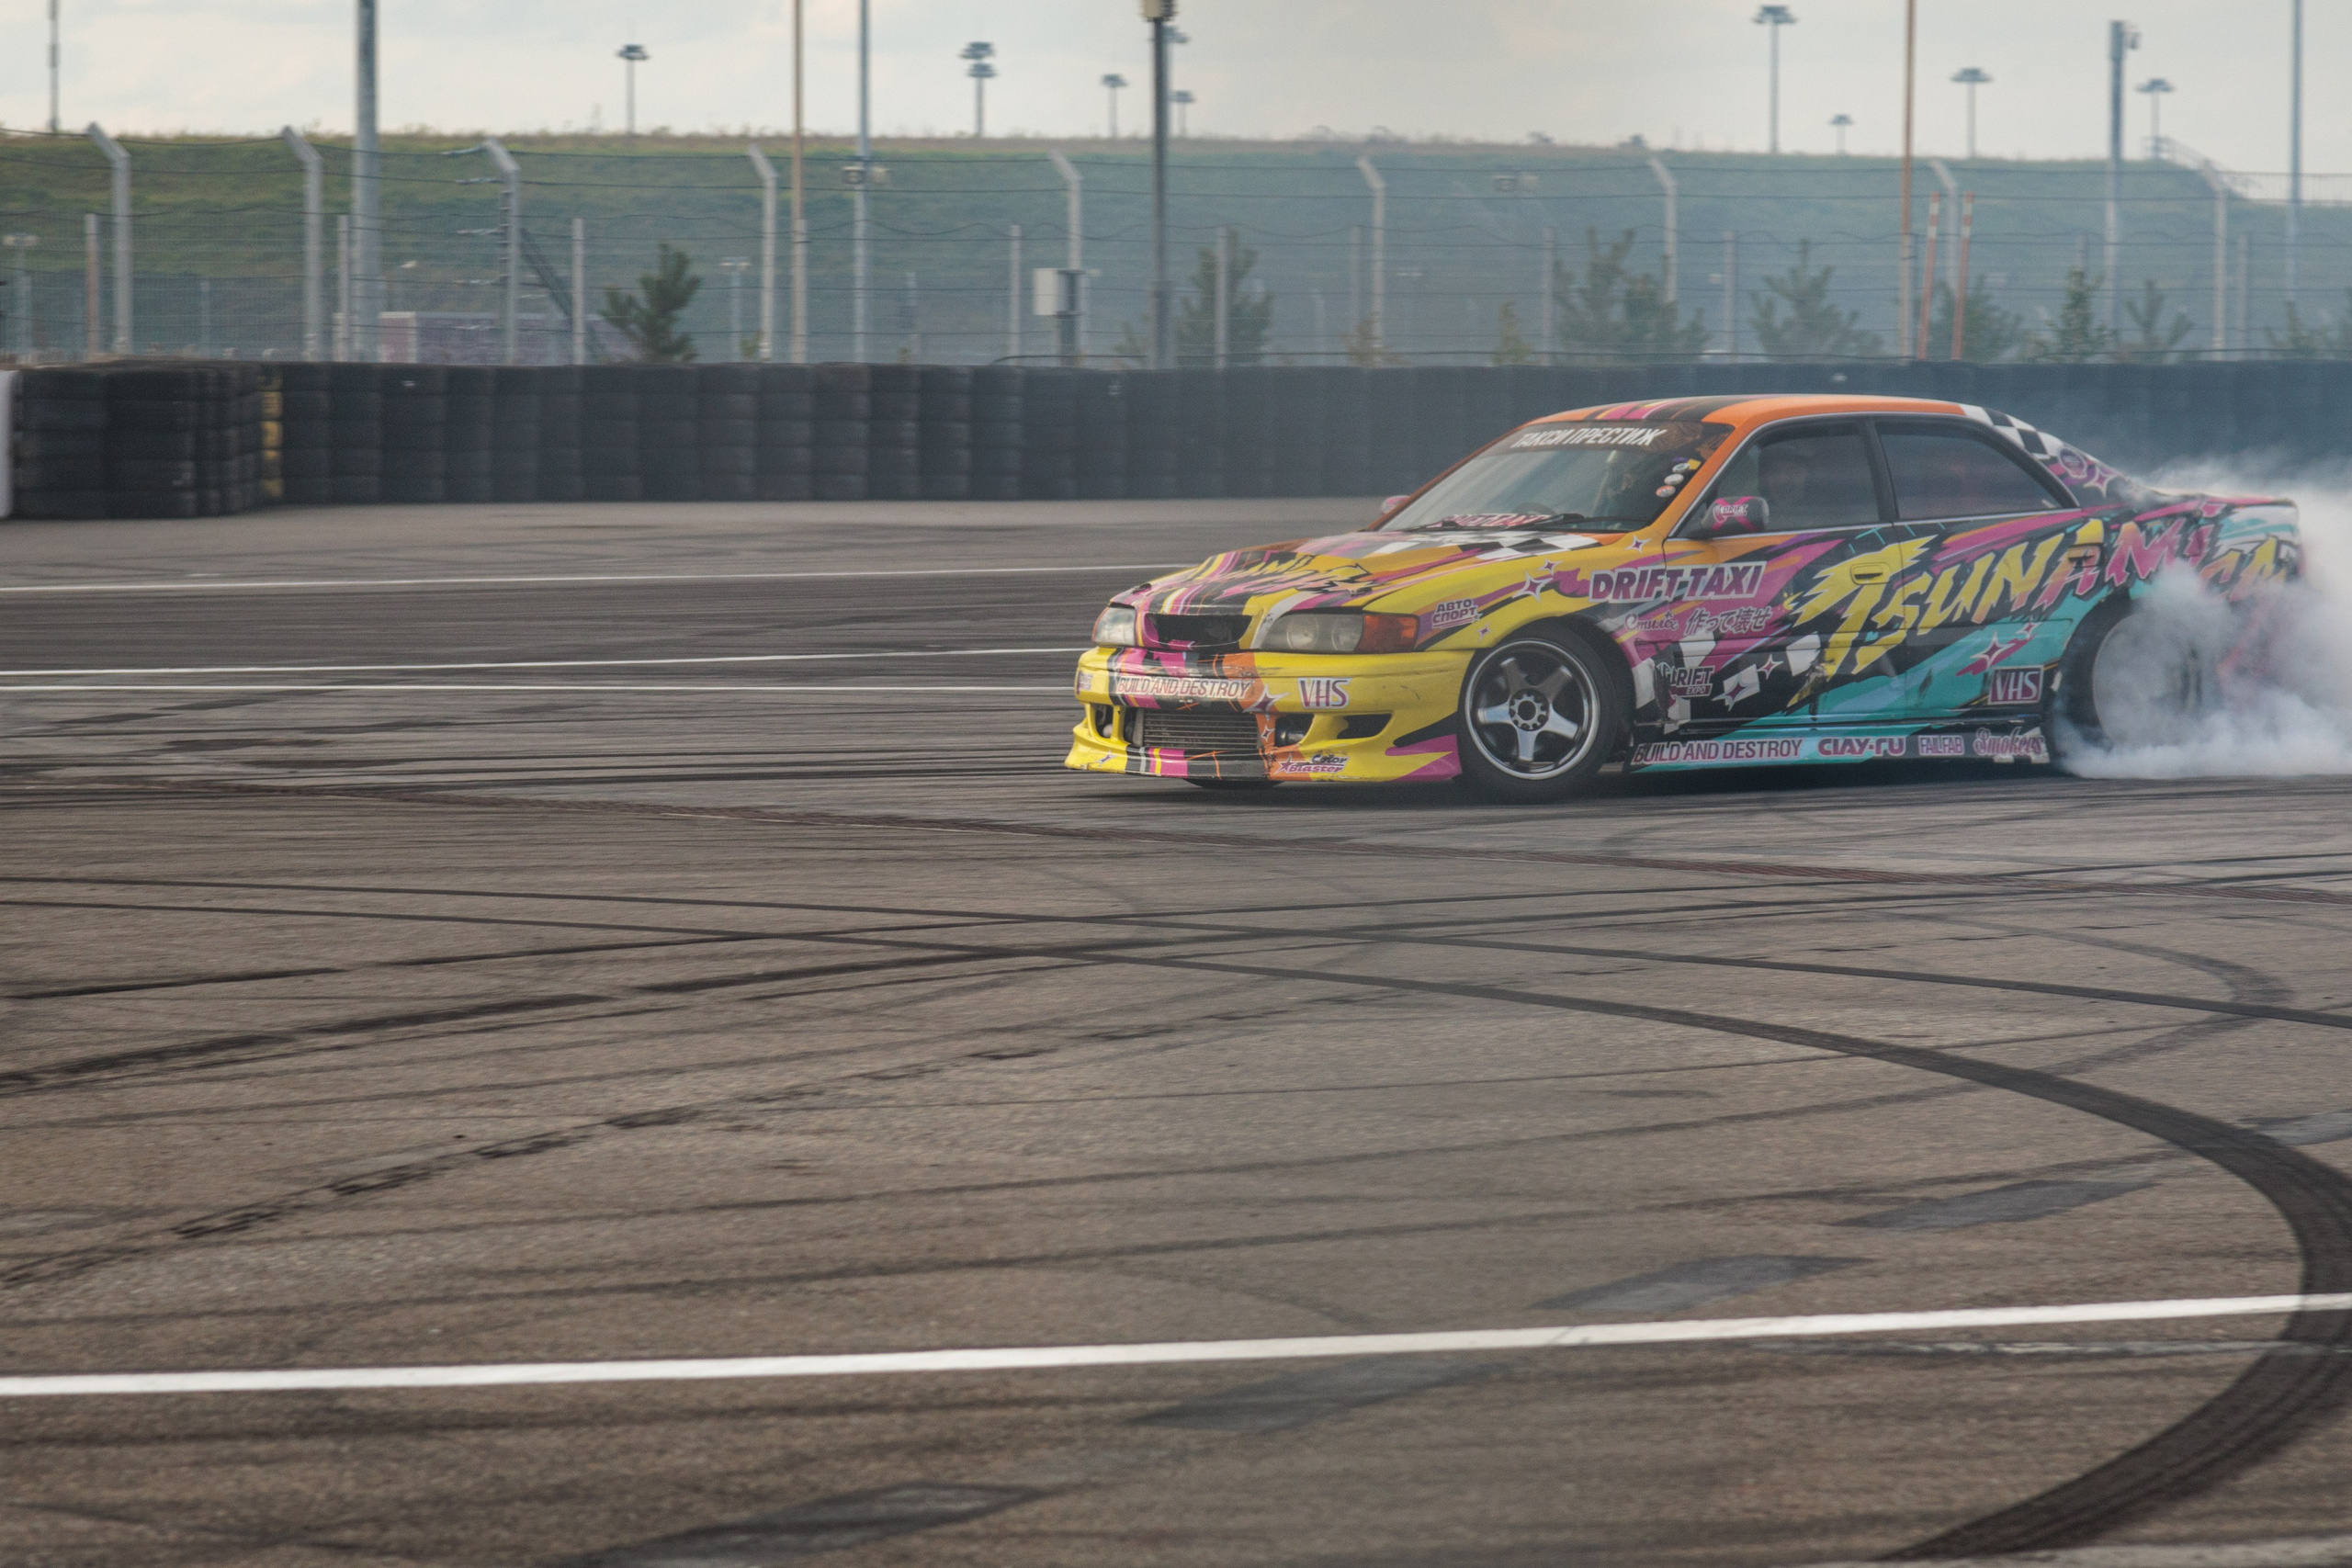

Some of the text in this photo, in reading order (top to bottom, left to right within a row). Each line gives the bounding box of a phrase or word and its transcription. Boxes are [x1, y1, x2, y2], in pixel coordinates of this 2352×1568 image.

[1562, 428, 1668, 446] ПРЕСТИЖ
[1432, 607, 1477, 624] СПОРТ
[1436, 599, 1473, 613] АВТО
[1117, 677, 1251, 698] BUILD AND DESTROY
[1299, 680, 1348, 707] VHS
[1994, 670, 2041, 701] VHS
[1633, 739, 1804, 763] BUILD AND DESTROY
